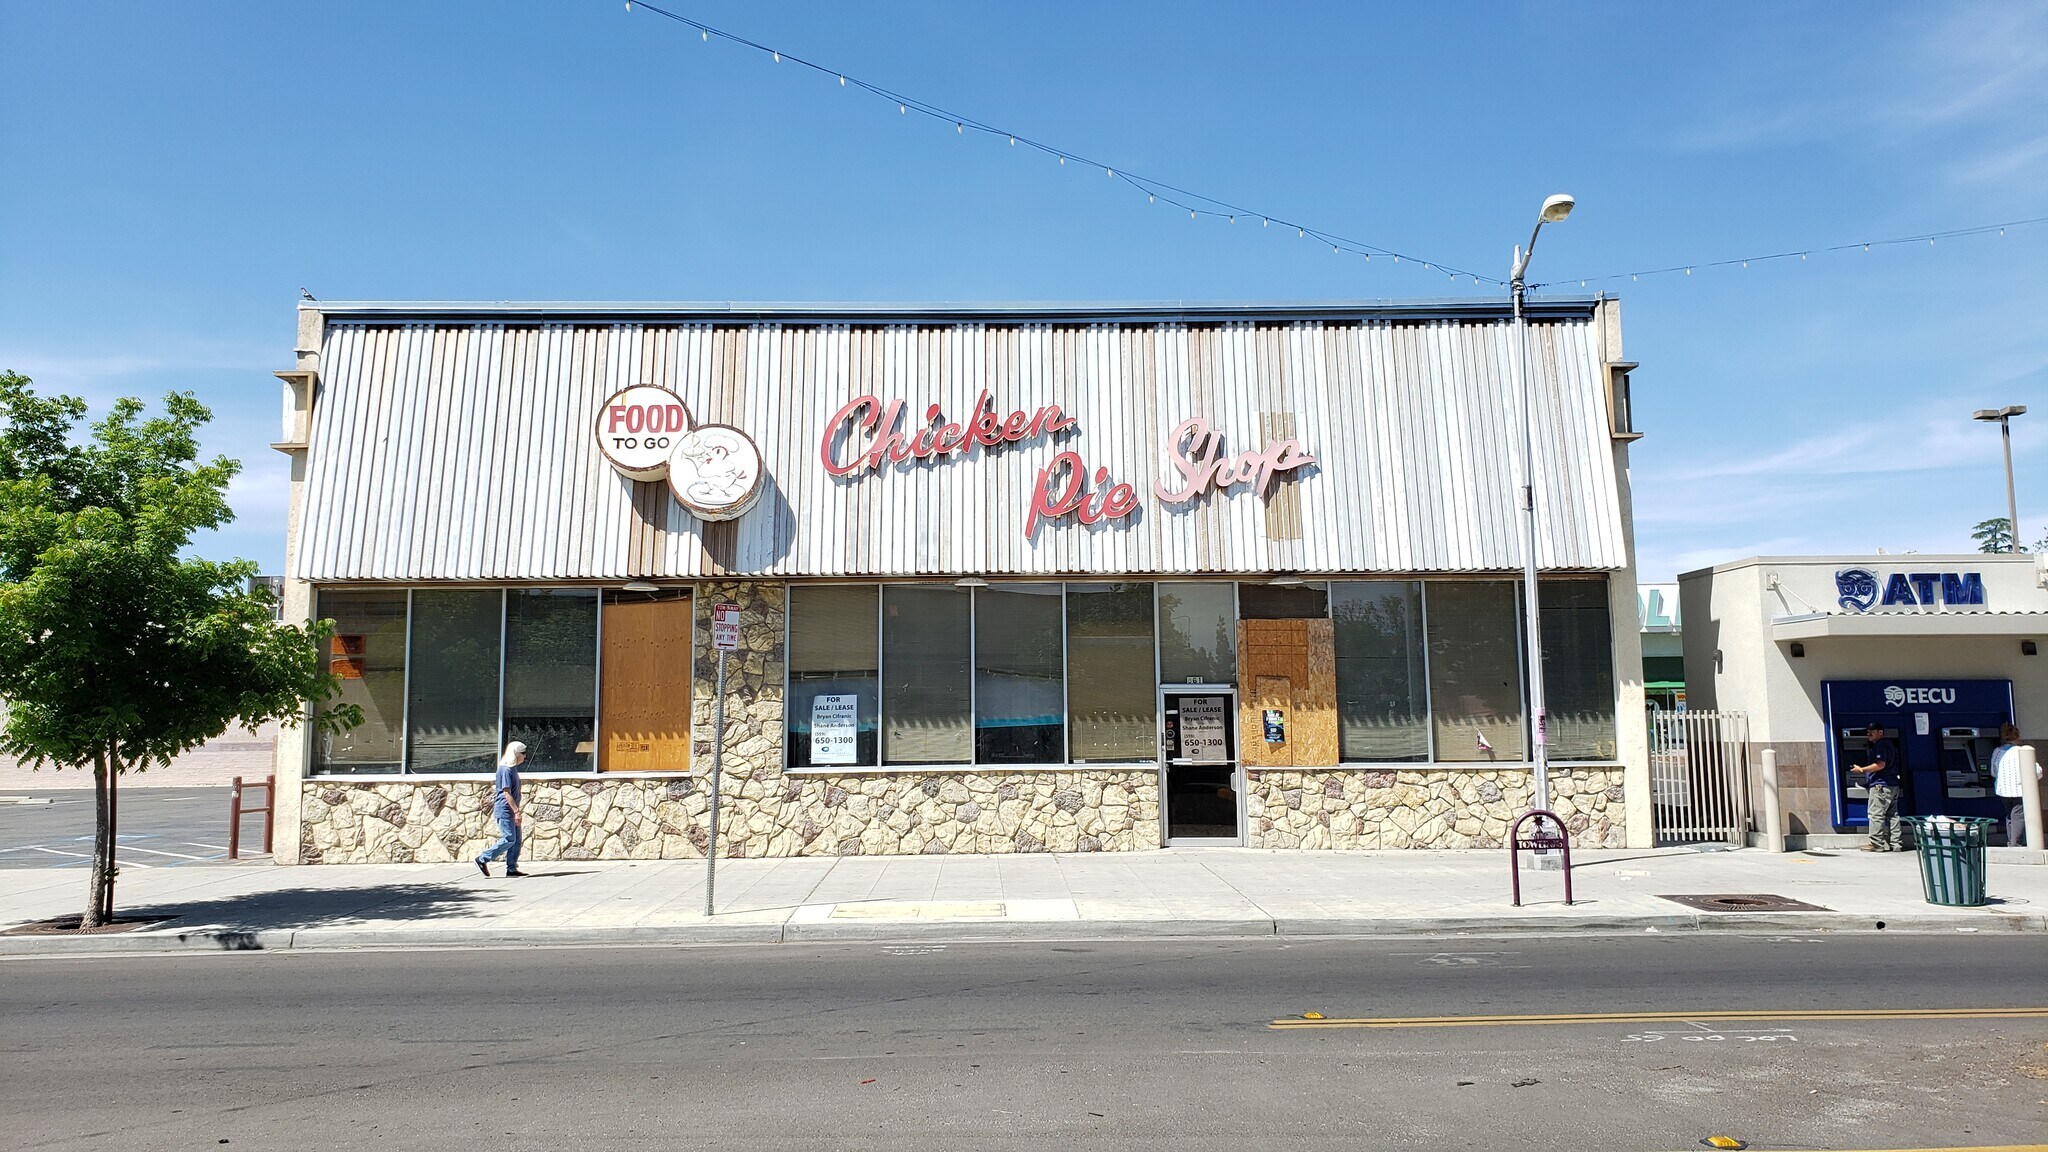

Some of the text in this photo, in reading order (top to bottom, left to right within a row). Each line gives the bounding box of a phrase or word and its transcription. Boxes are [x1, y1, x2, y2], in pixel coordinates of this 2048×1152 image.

[608, 404, 683, 433] FOOD
[820, 388, 1076, 478] Chicken
[613, 437, 670, 449] TO GO
[1025, 416, 1315, 540] Pie Shop
[1882, 572, 1984, 605] ATM
[716, 611, 724, 621] NO
[715, 623, 738, 632] STOPPING
[1906, 687, 1956, 704] EECU
[815, 736, 854, 744] 650-1300
[1184, 738, 1223, 746] 650-1300
